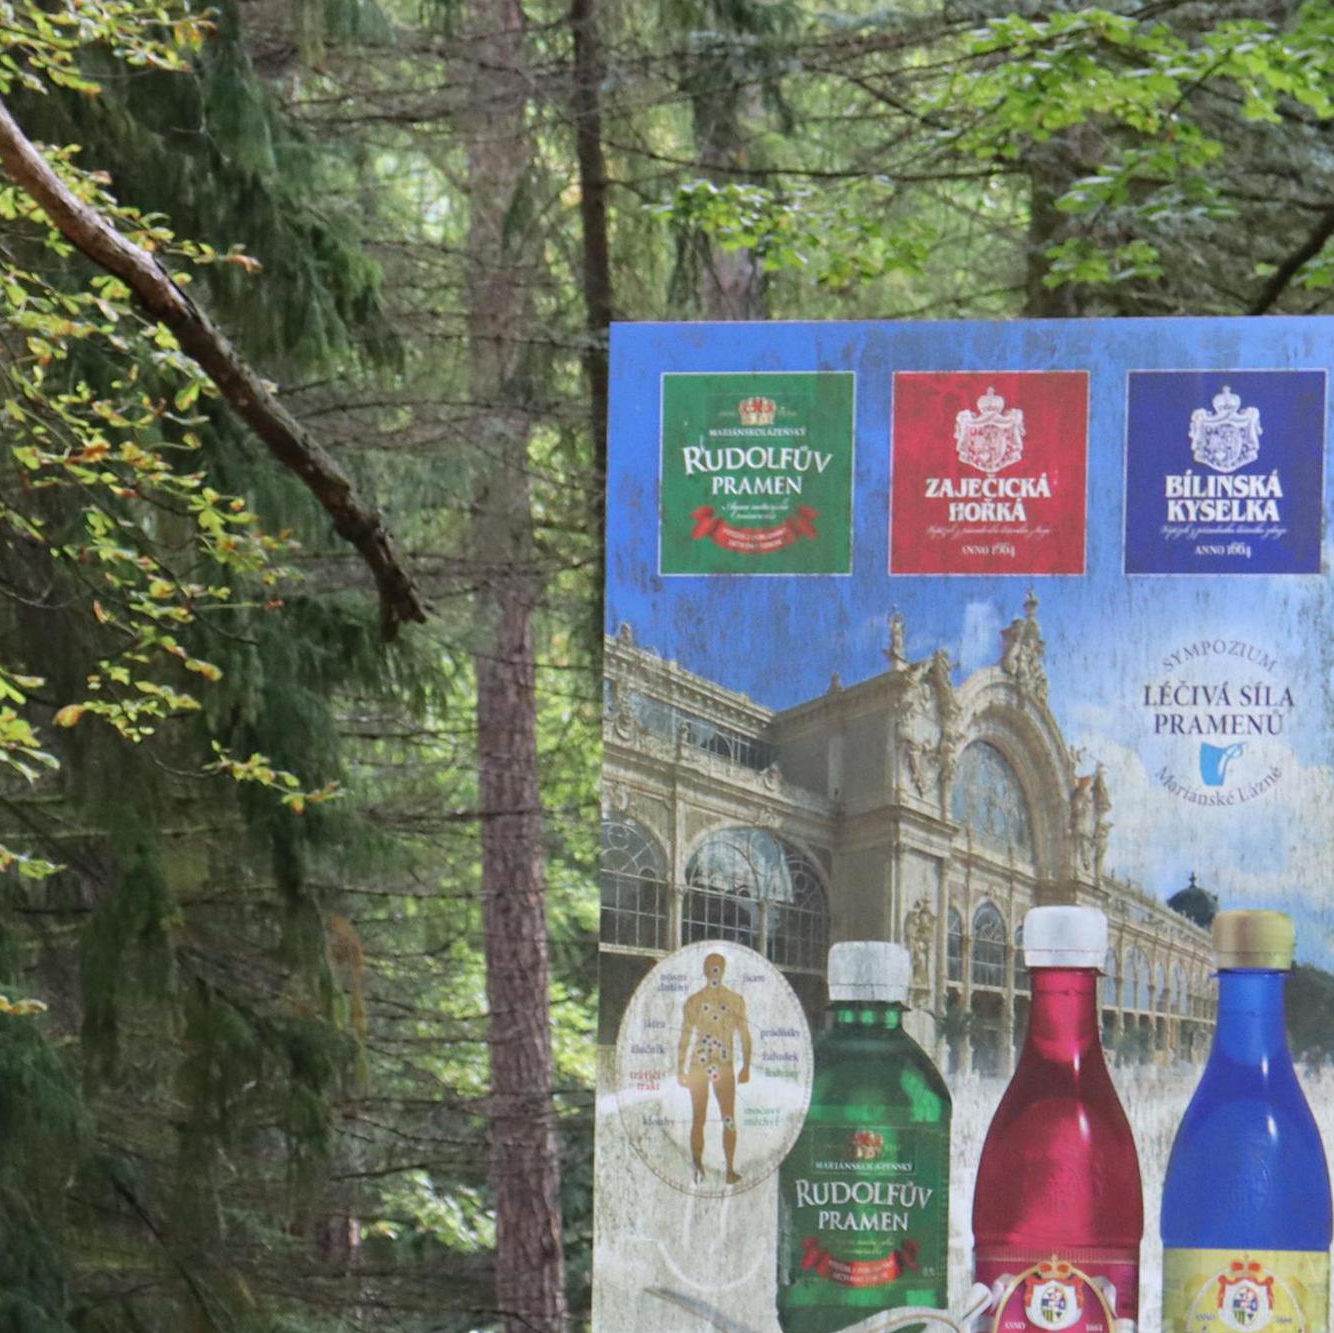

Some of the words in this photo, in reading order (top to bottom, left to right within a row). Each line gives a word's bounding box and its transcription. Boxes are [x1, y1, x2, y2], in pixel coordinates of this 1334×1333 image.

[683, 445, 833, 475] RUDOLFŮV
[712, 476, 803, 495] PRAMEN
[925, 472, 1051, 498] ZAJEČICKÁ
[1165, 469, 1283, 498] BÍLINSKÁ
[948, 498, 1027, 522] HOŘKÁ
[1167, 500, 1280, 522] KYSELKA
[1195, 545, 1225, 555] ANNO
[1162, 639, 1278, 672] SYMPOZIUM
[1144, 680, 1231, 707] LÉČIVÁ
[1239, 681, 1295, 707] SÍLA
[1155, 709, 1284, 736] PRAMENŮ
[1155, 766, 1235, 807] Mariánské
[795, 1179, 933, 1209] RUDOLFŮV
[819, 1211, 909, 1232] PRAMEN
